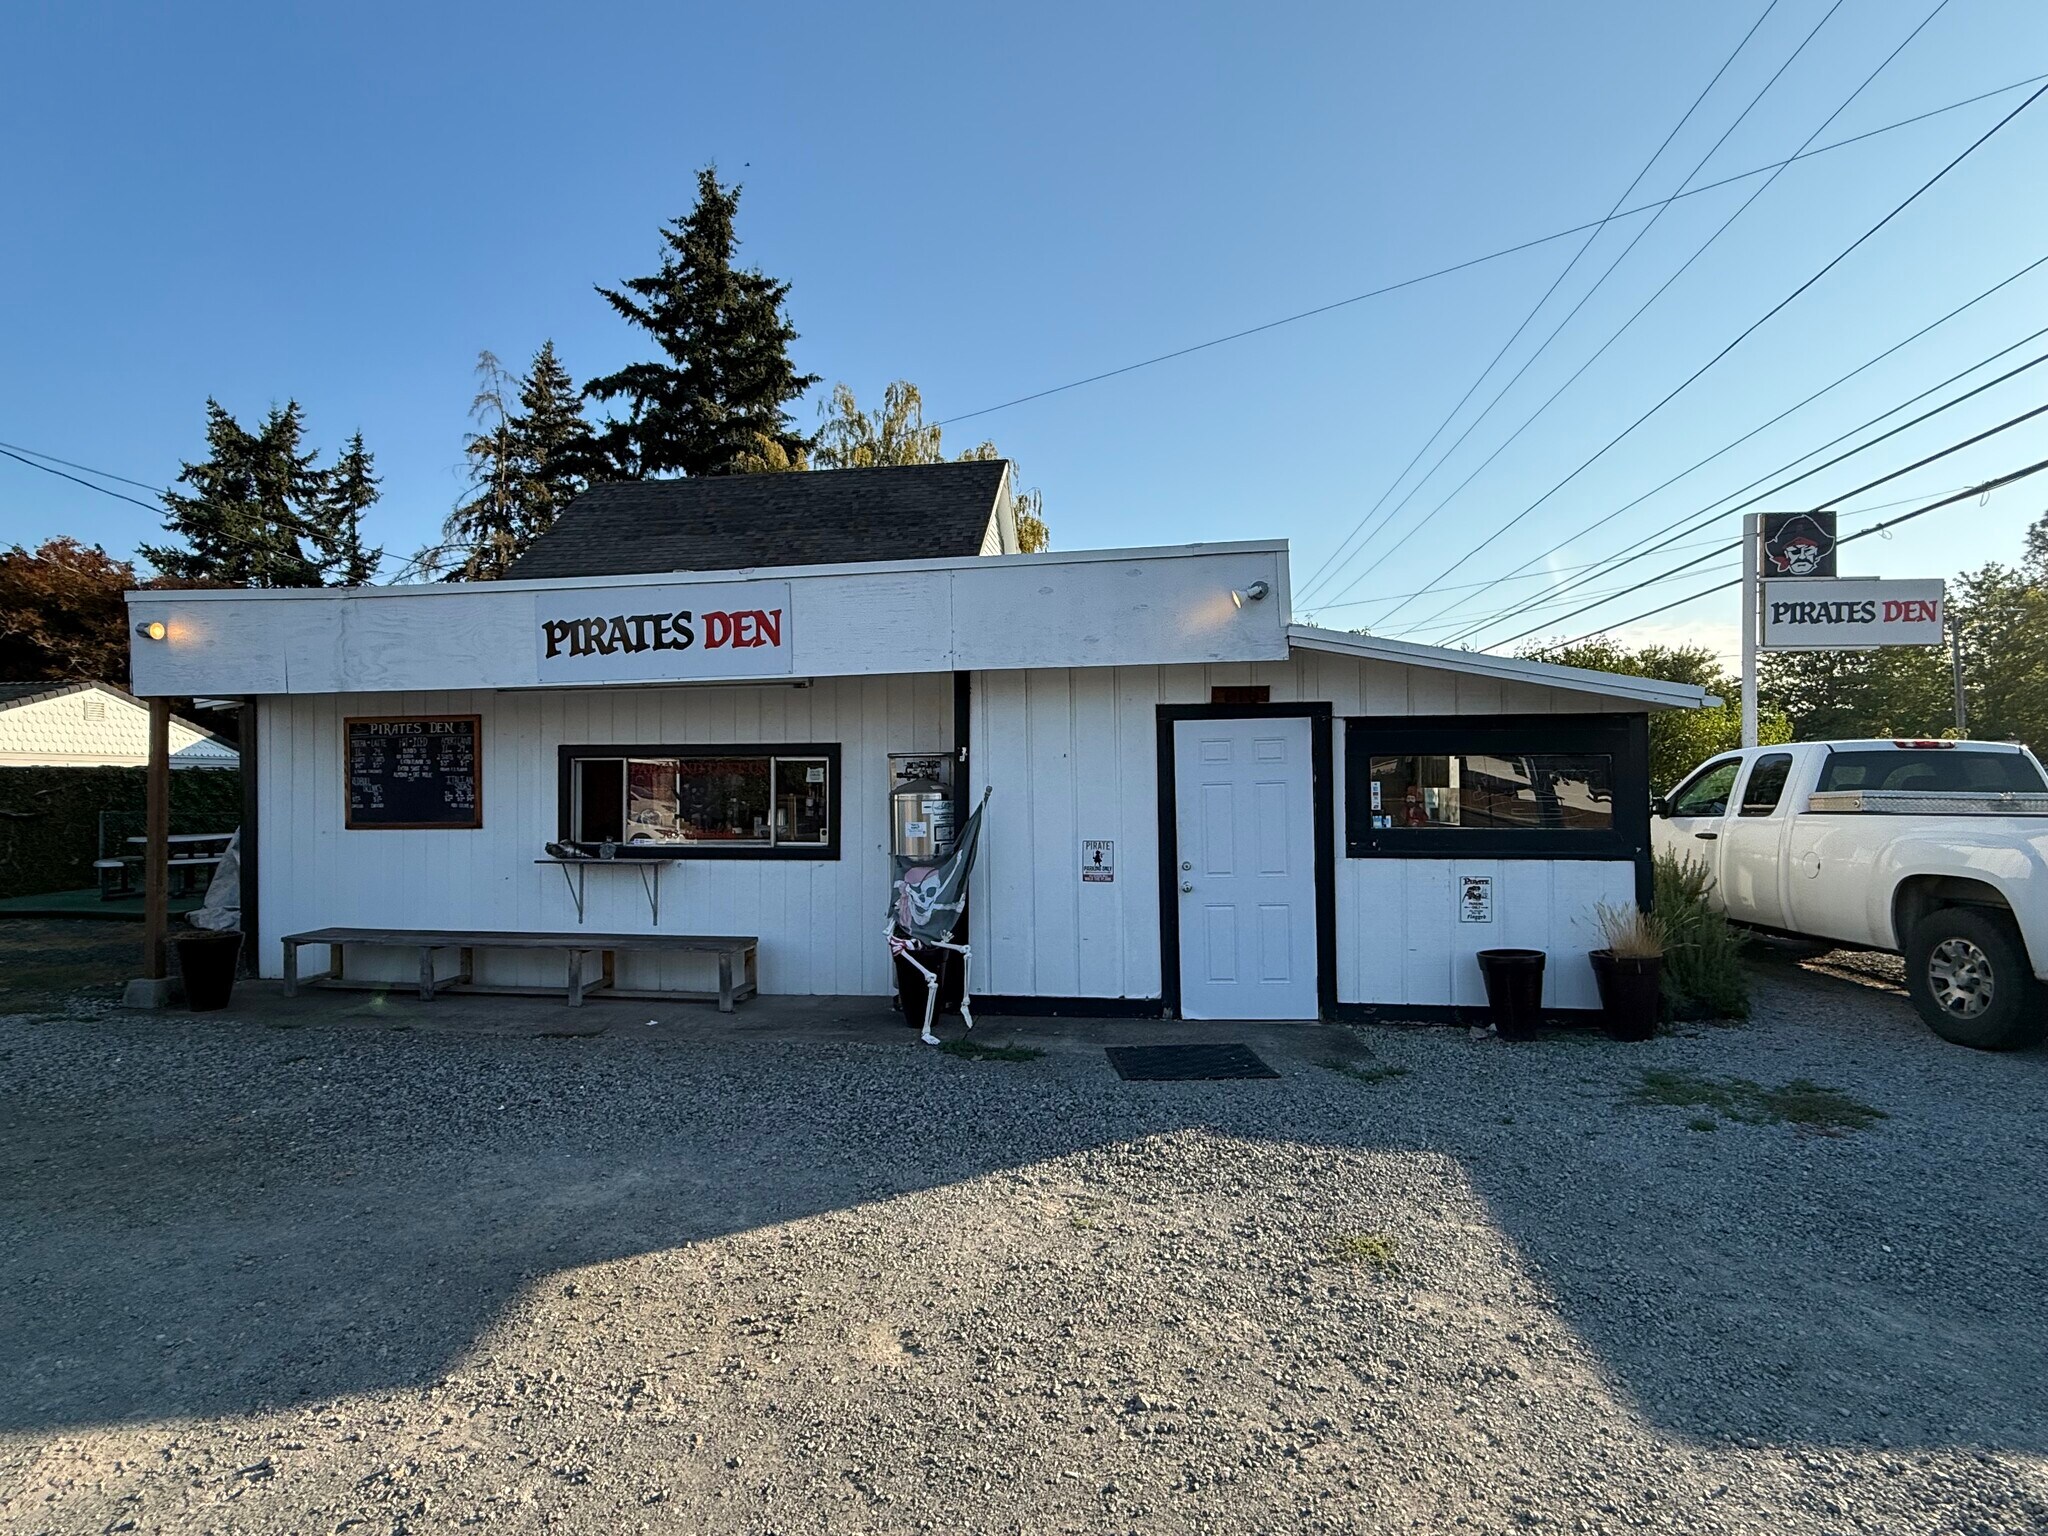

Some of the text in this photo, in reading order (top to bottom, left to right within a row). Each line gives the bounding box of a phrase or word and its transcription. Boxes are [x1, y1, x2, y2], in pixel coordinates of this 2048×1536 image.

[1771, 600, 1937, 624] PIRATES DEN
[542, 609, 782, 659] PIRATES DEN
[369, 721, 455, 736] PIRATES DEN
[1085, 842, 1110, 850] PIRATE
